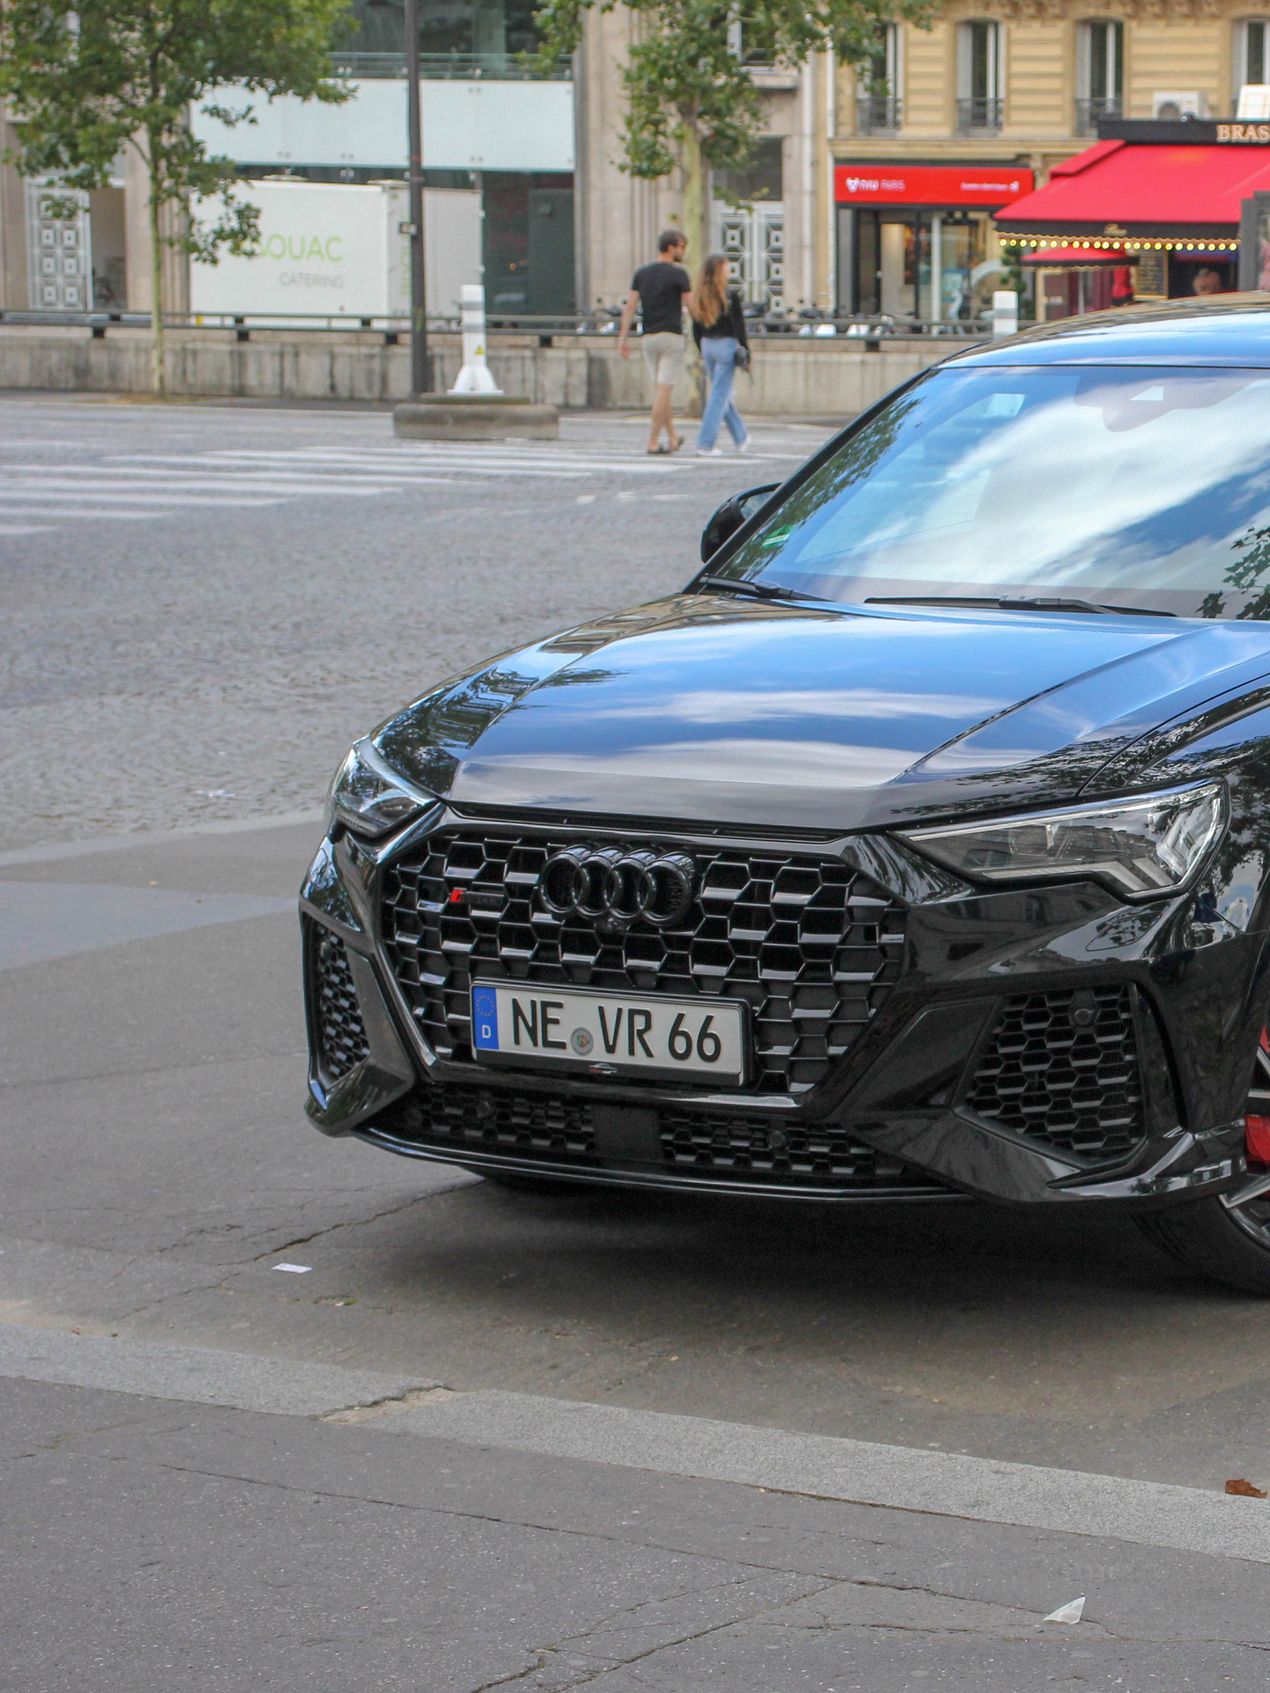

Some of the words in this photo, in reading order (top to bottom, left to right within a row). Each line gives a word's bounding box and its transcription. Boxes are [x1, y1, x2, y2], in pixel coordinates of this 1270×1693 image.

[279, 271, 345, 288] CATERING
[481, 1025, 492, 1040] D
[511, 996, 568, 1051] NE
[597, 1005, 655, 1058] VR
[667, 1012, 723, 1064] 66
